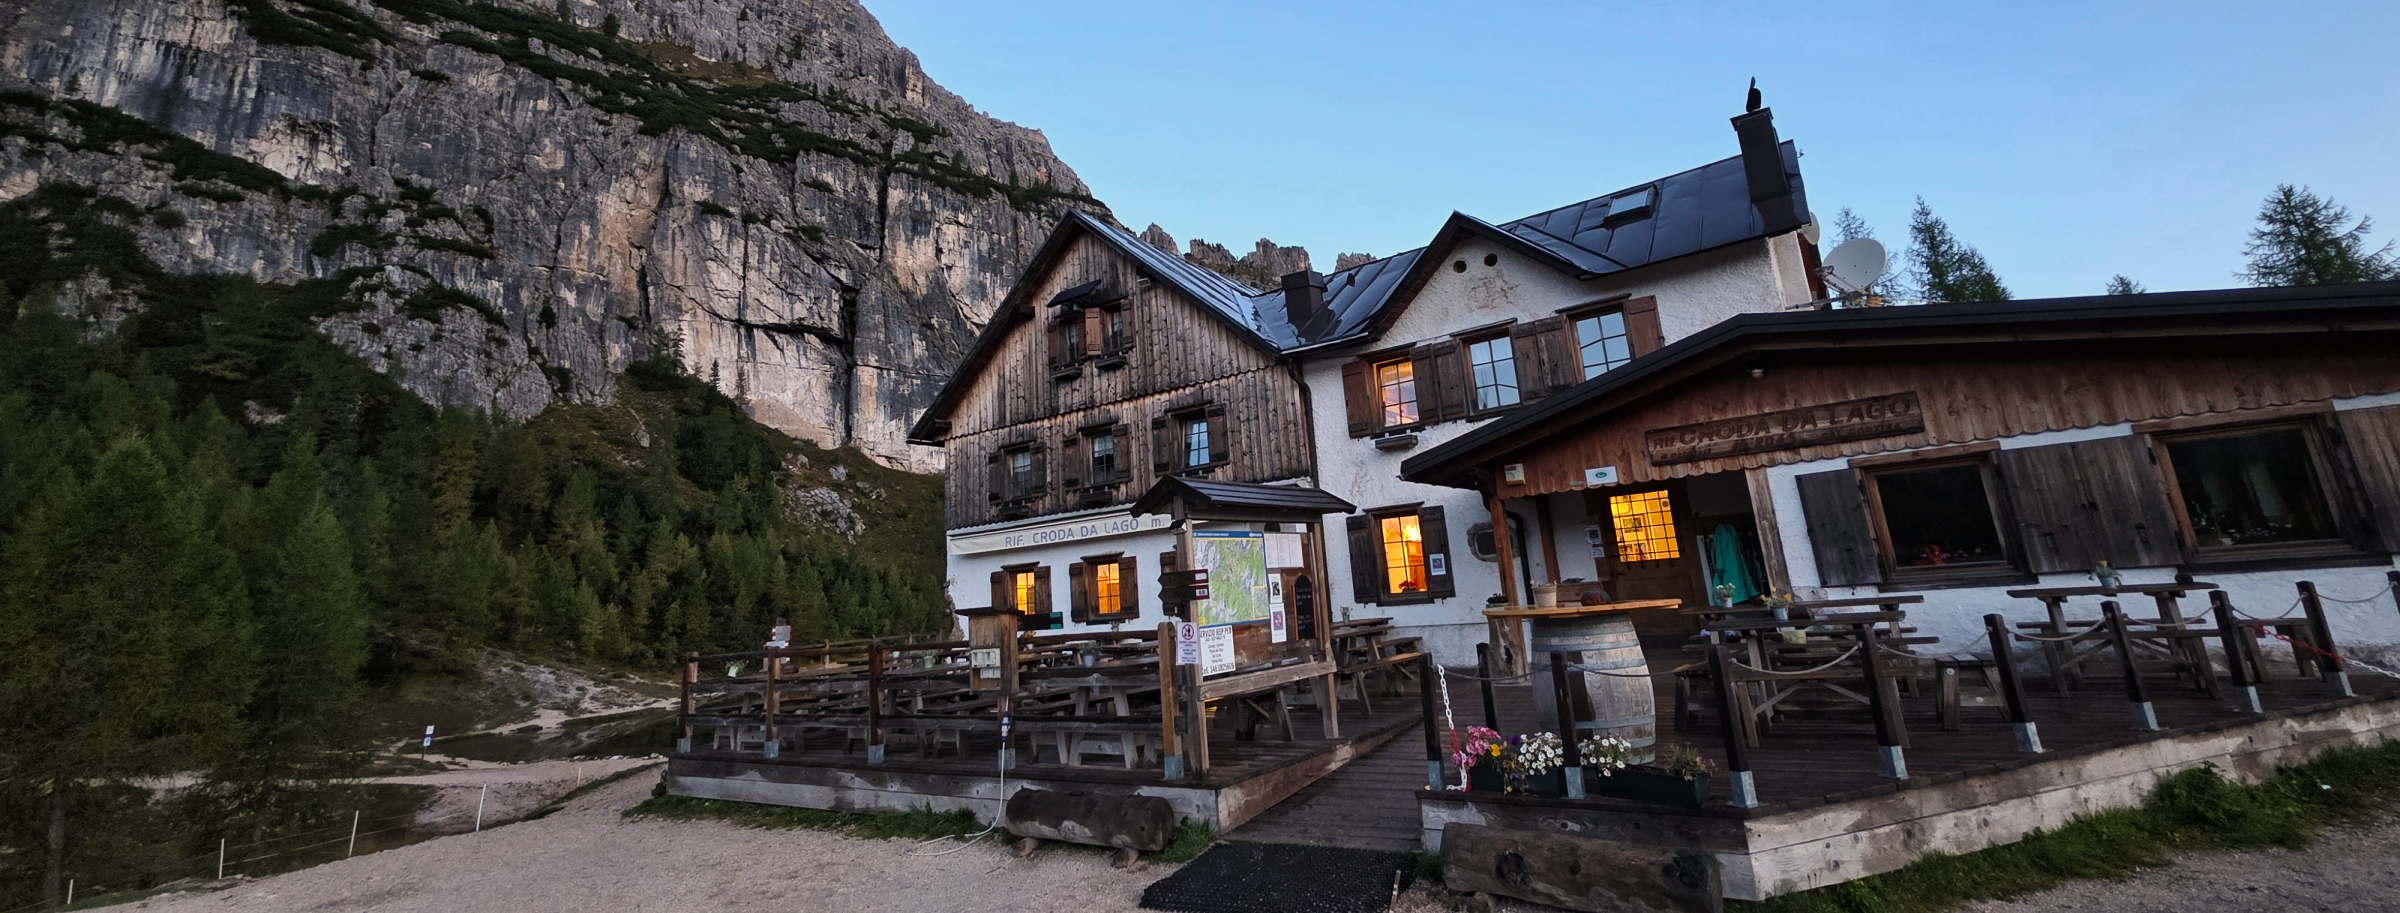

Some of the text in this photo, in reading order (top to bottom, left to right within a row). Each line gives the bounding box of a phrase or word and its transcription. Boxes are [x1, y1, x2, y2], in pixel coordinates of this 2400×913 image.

[1680, 417, 1771, 445] CRODA
[1782, 410, 1818, 432] DA
[1827, 398, 1911, 425] LAGO
[1005, 518, 1166, 548] RIF. CRODA DA LAGO m.
